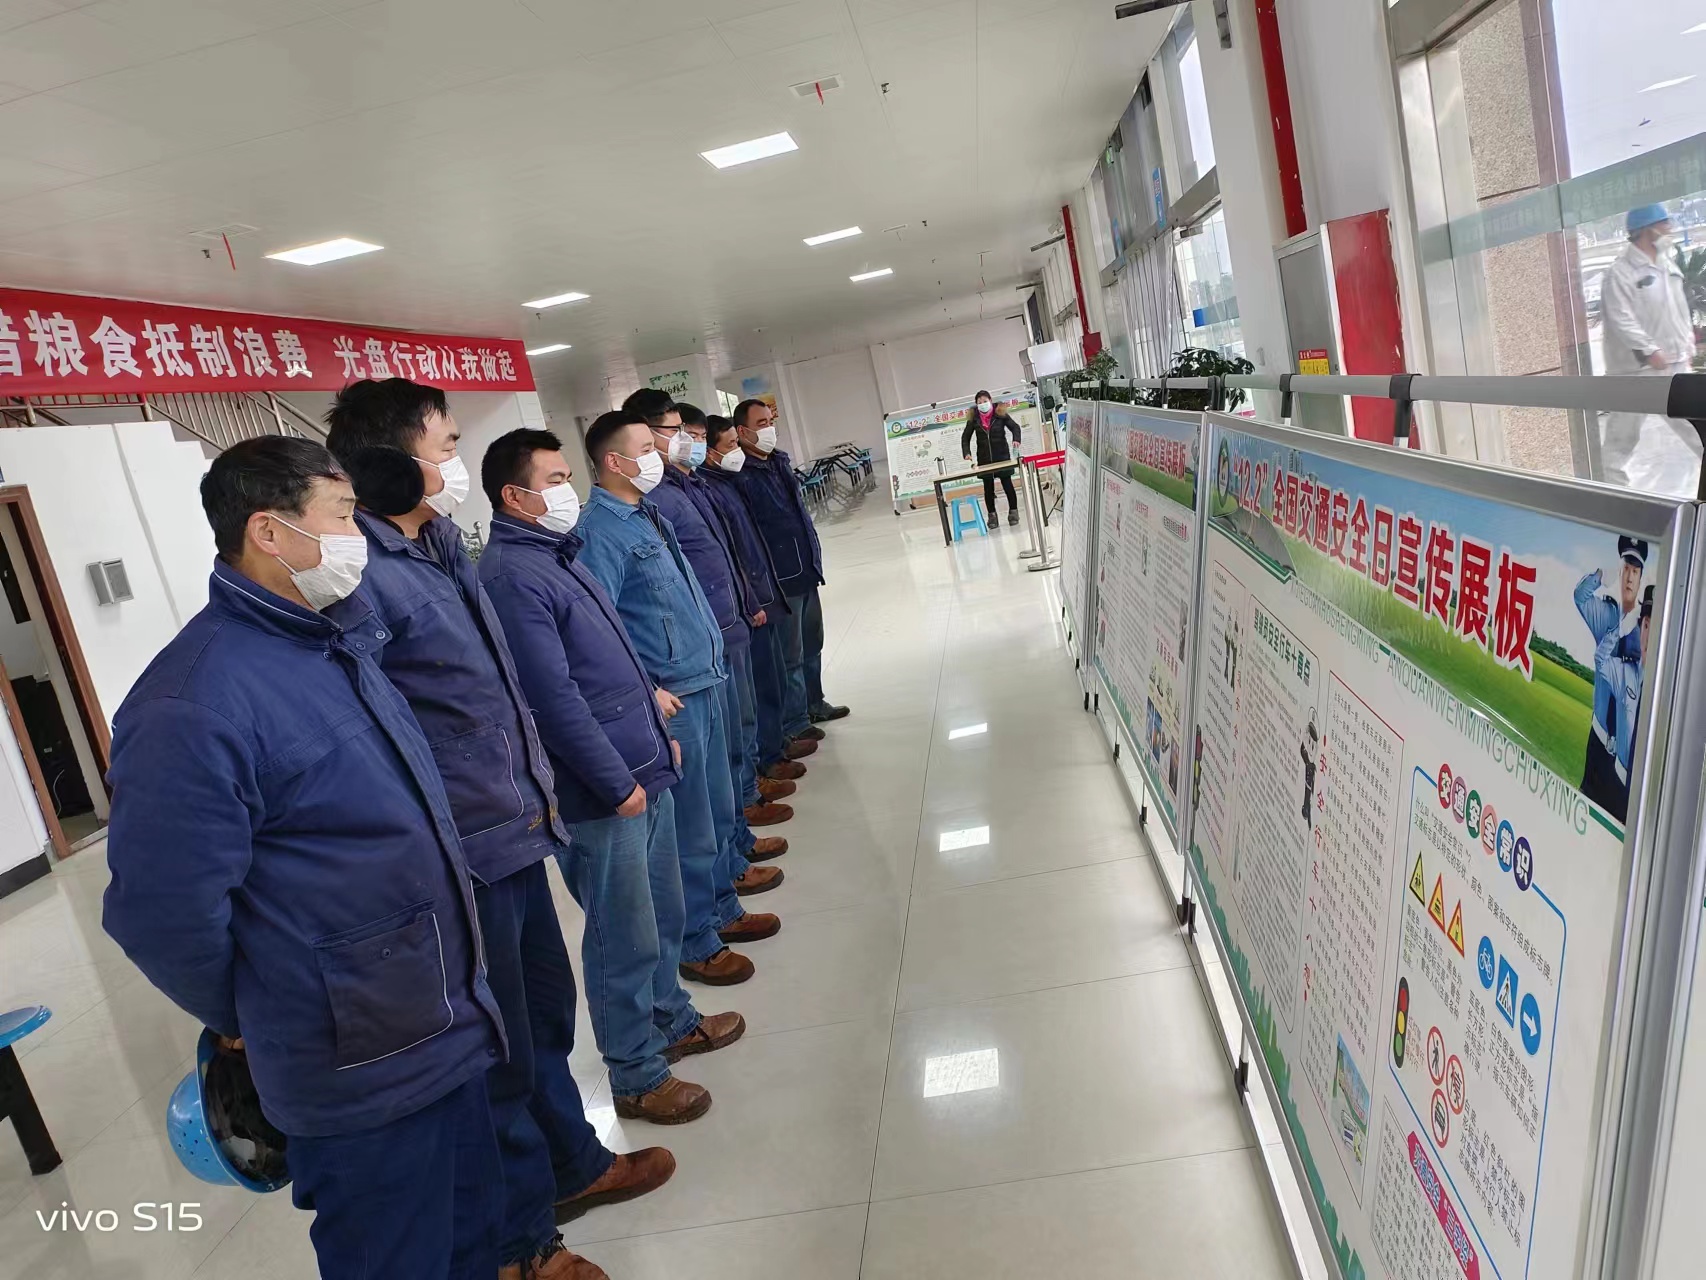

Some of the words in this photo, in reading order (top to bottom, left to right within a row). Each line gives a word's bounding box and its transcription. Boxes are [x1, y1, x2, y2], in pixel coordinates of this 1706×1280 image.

[333, 335, 517, 382] 光盘行动从我做起
[1272, 466, 1537, 682] 全国交通安全日宣传展板
[1387, 652, 1588, 835] ANQUANWENMINGCHUXING
[1439, 770, 1530, 886] 交通安全常识
